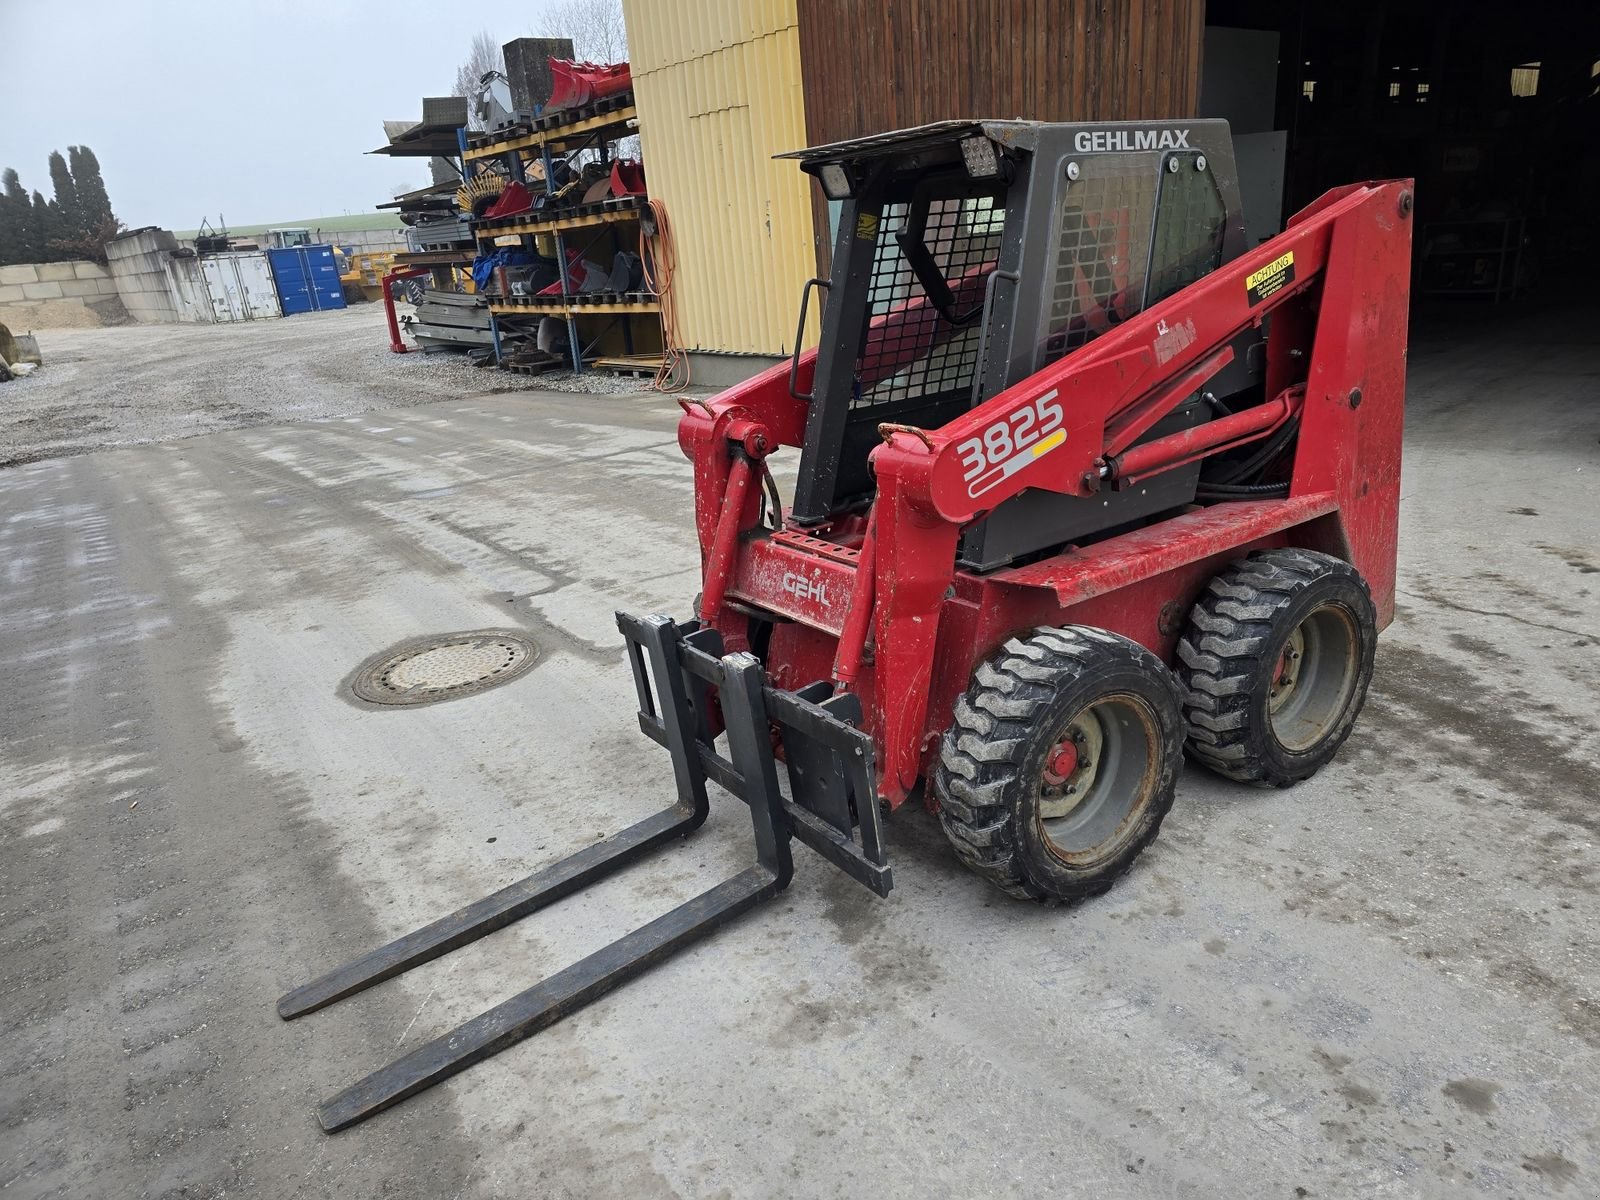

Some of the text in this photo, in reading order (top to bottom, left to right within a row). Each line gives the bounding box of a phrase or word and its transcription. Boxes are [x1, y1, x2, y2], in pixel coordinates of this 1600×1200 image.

[1074, 129, 1190, 152] GEHLMAX
[1252, 256, 1289, 286] ACHTUNG
[956, 389, 1063, 482] 3825
[782, 572, 831, 607] GEHL
